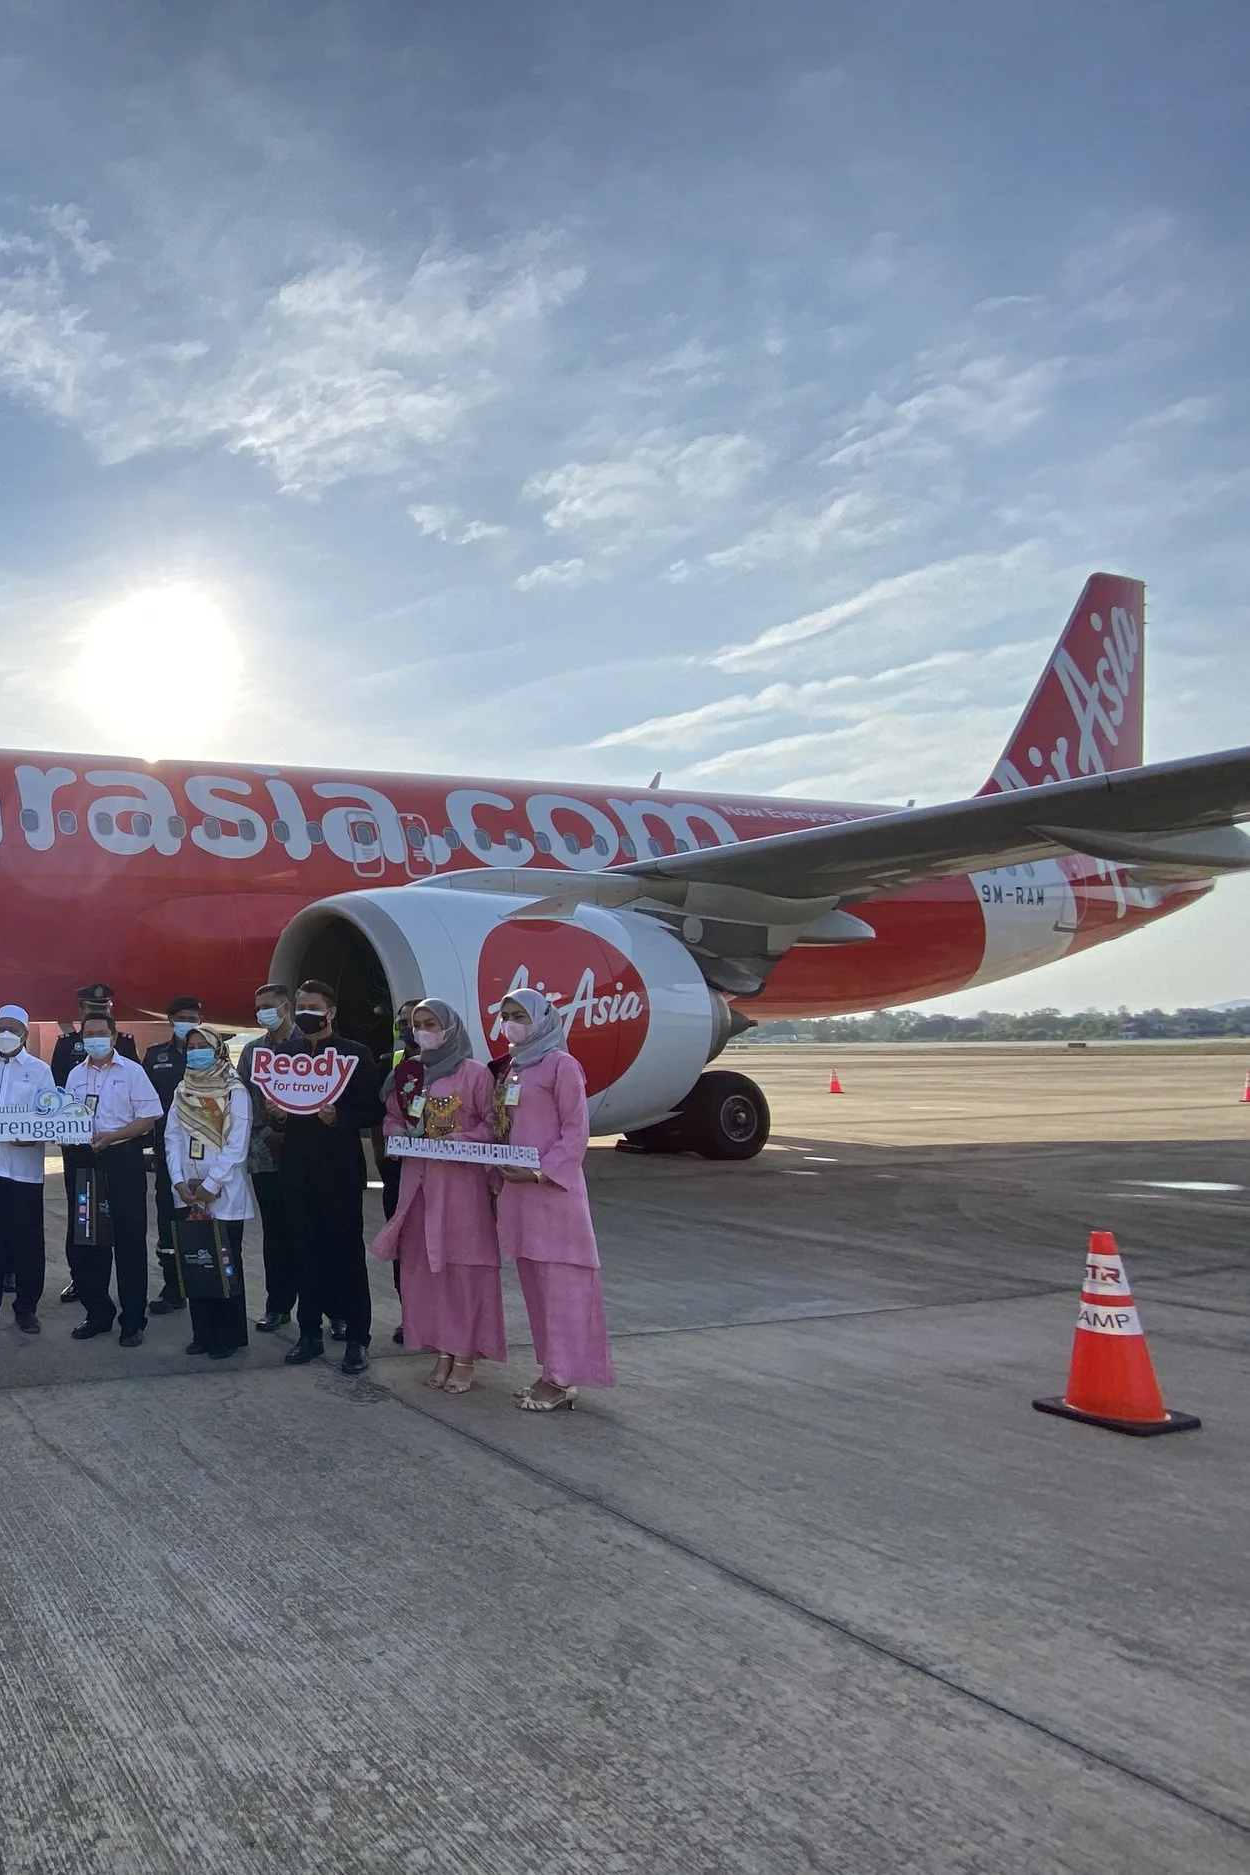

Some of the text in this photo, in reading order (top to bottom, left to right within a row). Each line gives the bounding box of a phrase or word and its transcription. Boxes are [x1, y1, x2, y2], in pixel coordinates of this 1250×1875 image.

[991, 606, 1138, 793] ArAsia
[718, 804, 764, 818] Now
[762, 807, 843, 823] Everyone
[254, 1051, 355, 1080] Ready
[273, 1080, 329, 1093] for travel
[1084, 1264, 1121, 1284] TR
[1078, 1310, 1129, 1329] AMP
